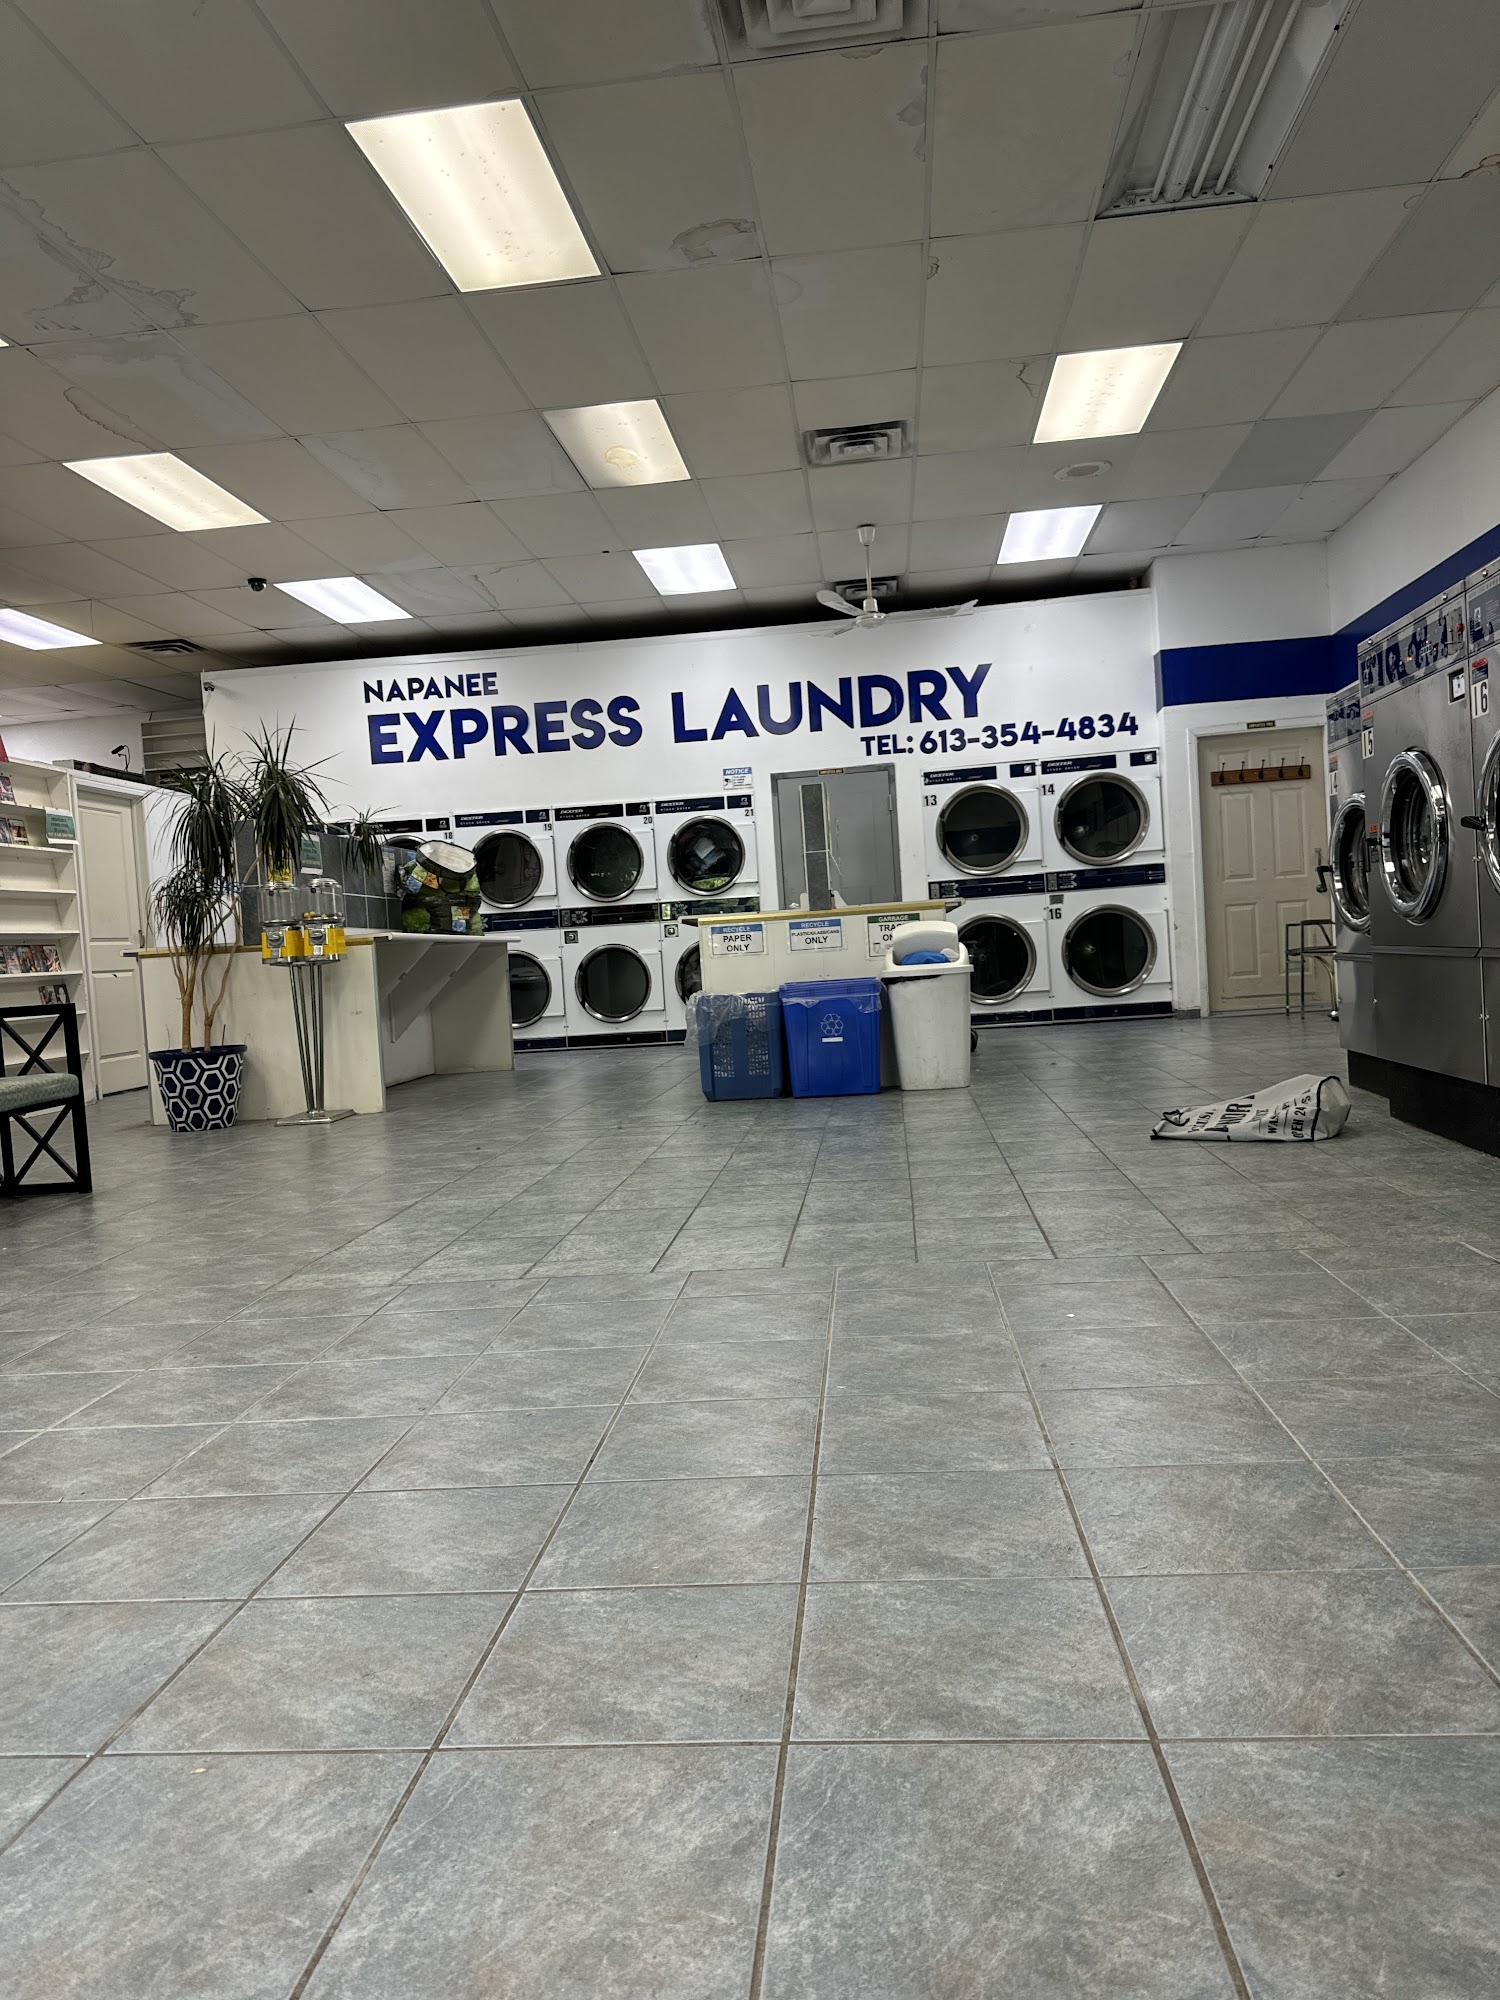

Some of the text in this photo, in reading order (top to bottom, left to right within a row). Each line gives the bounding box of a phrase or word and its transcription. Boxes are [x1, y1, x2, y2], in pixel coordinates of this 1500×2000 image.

[363, 671, 499, 704] NAPANEE
[1474, 681, 1488, 716] 16
[367, 663, 993, 765] EXPRESS LAUNDRY
[860, 711, 1139, 757] TEL: 613-354-4834
[1363, 729, 1373, 758] 15
[725, 767, 749, 775] NOTICE
[1041, 783, 1055, 796] 14
[923, 795, 937, 806] 13
[745, 809, 754, 817] 21
[643, 816, 653, 825] 20
[543, 823, 553, 832] 19
[444, 832, 453, 840] 18
[878, 914, 909, 922] GARBAGE
[1048, 908, 1062, 919] 16
[723, 934, 752, 943] PAPER
[805, 936, 829, 945] ONLY
[726, 943, 750, 953] ONLY
